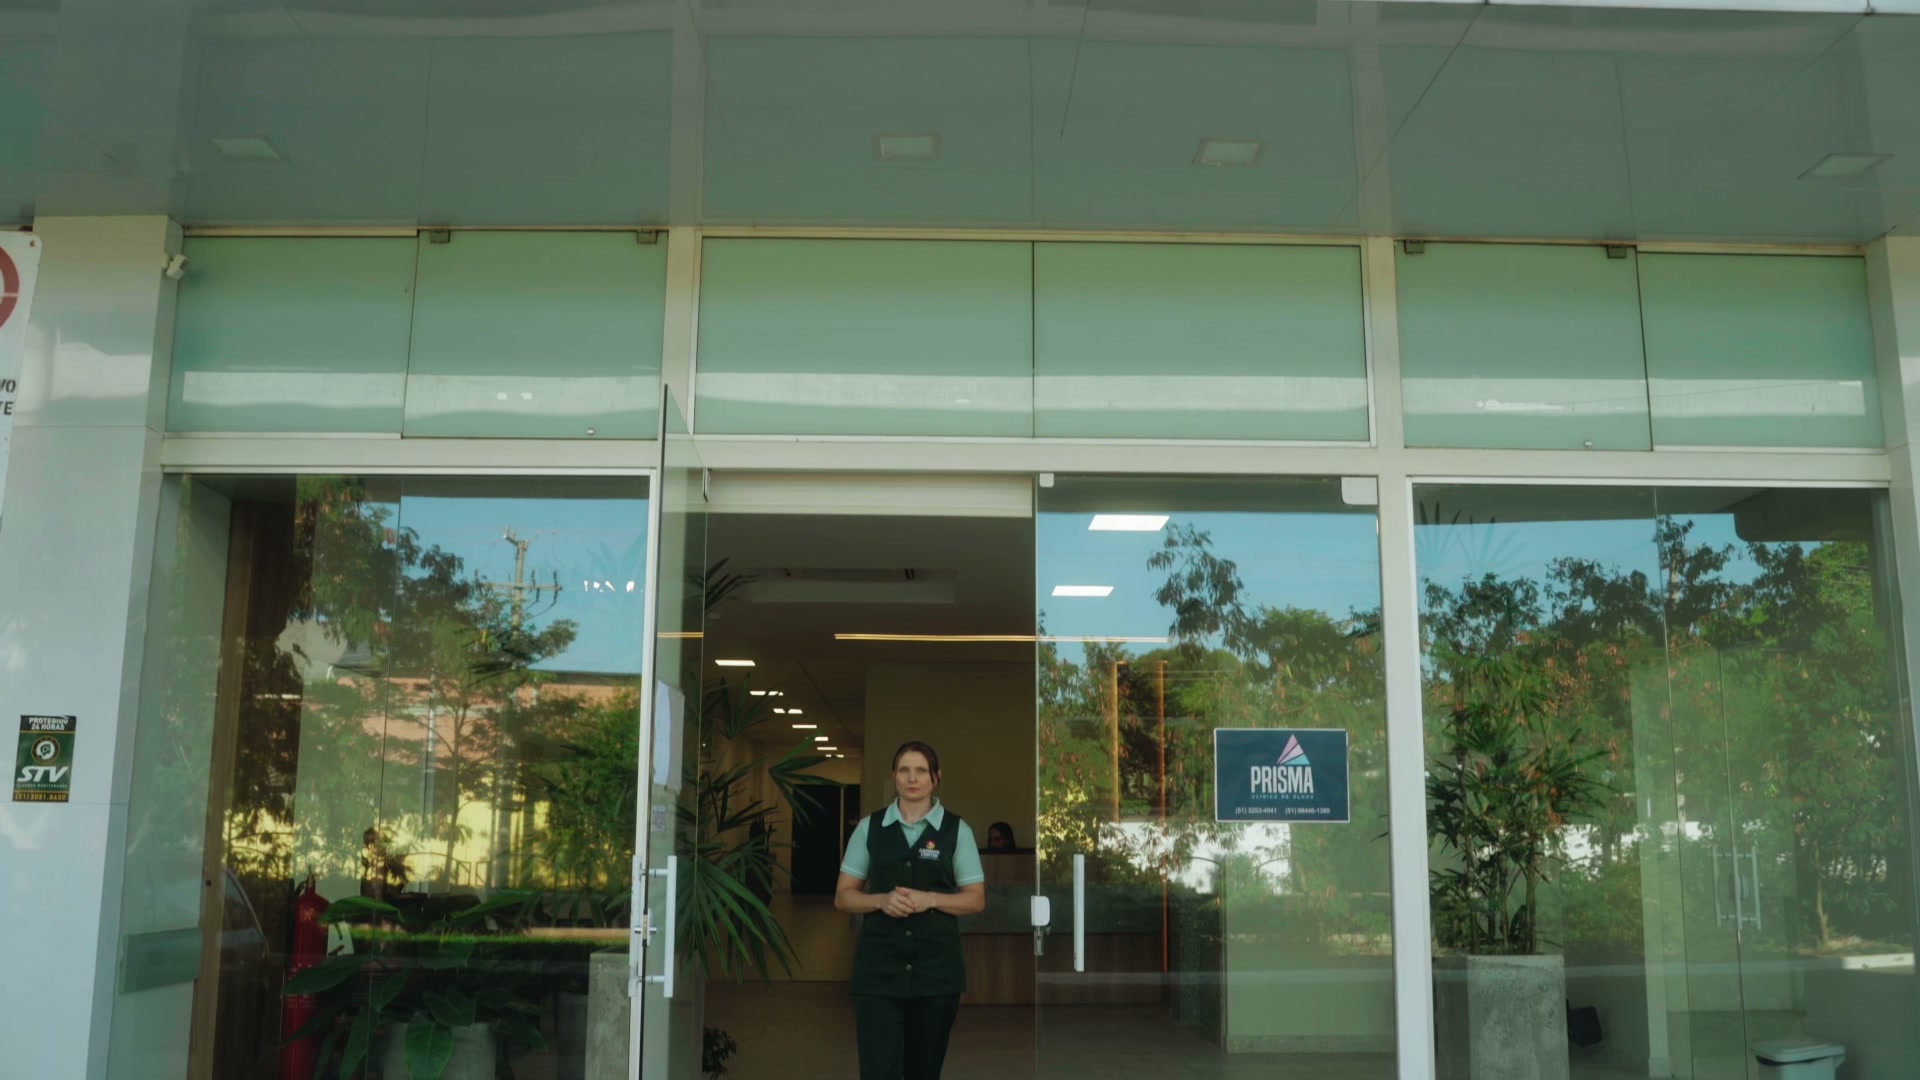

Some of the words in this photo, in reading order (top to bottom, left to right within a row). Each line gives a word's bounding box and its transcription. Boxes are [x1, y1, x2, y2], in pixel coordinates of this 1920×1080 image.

[17, 766, 69, 782] STV
[1250, 766, 1314, 793] PRISMA
[1235, 807, 1247, 815] (51)
[1285, 807, 1297, 815] (51)
